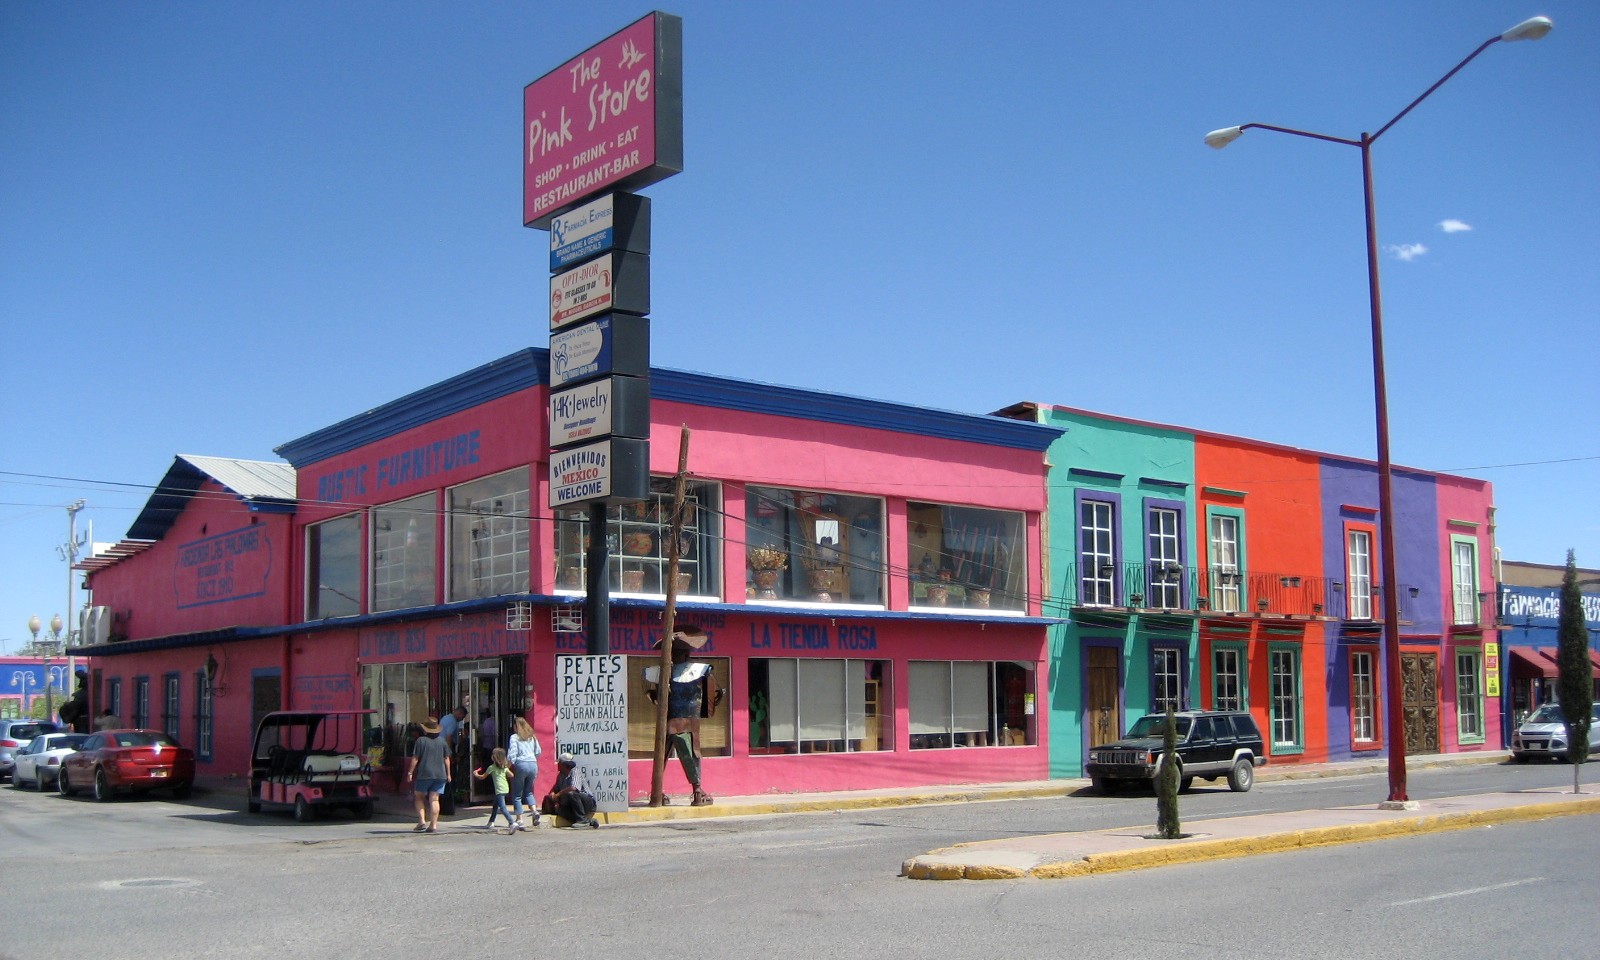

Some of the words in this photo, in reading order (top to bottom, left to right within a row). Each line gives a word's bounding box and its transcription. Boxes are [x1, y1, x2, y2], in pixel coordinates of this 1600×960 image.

[570, 56, 601, 93] The
[529, 106, 572, 164] Pink
[588, 69, 650, 131] Store
[535, 164, 562, 188] SHOP
[573, 141, 606, 169] DRINK
[617, 126, 639, 147] EAT
[534, 150, 639, 212] RESTAURANT-BAR
[589, 208, 613, 223] EXPRESS
[552, 331, 576, 344] AMERICAN
[318, 464, 368, 502] RUSTIC
[376, 429, 481, 491] FURNITURE
[553, 451, 606, 479] BIENVENIDOS
[562, 467, 598, 485] MEXICO
[558, 482, 602, 501] WELCOME
[751, 622, 772, 648] LA
[779, 623, 829, 649] TIENDA
[838, 625, 877, 650] ROSA
[564, 655, 621, 674] PETE'S
[564, 675, 614, 693] PLACE
[563, 693, 580, 706] LES
[584, 692, 615, 705] INVITA
[618, 693, 624, 705] A
[560, 707, 571, 719] SU
[573, 706, 595, 719] GRAN
[597, 703, 625, 719] BAILE
[560, 743, 590, 755] GRUPO
[593, 741, 623, 755] SAGAZ
[591, 768, 600, 777] 13
[608, 780, 614, 789] 2
[615, 780, 627, 790] AM
